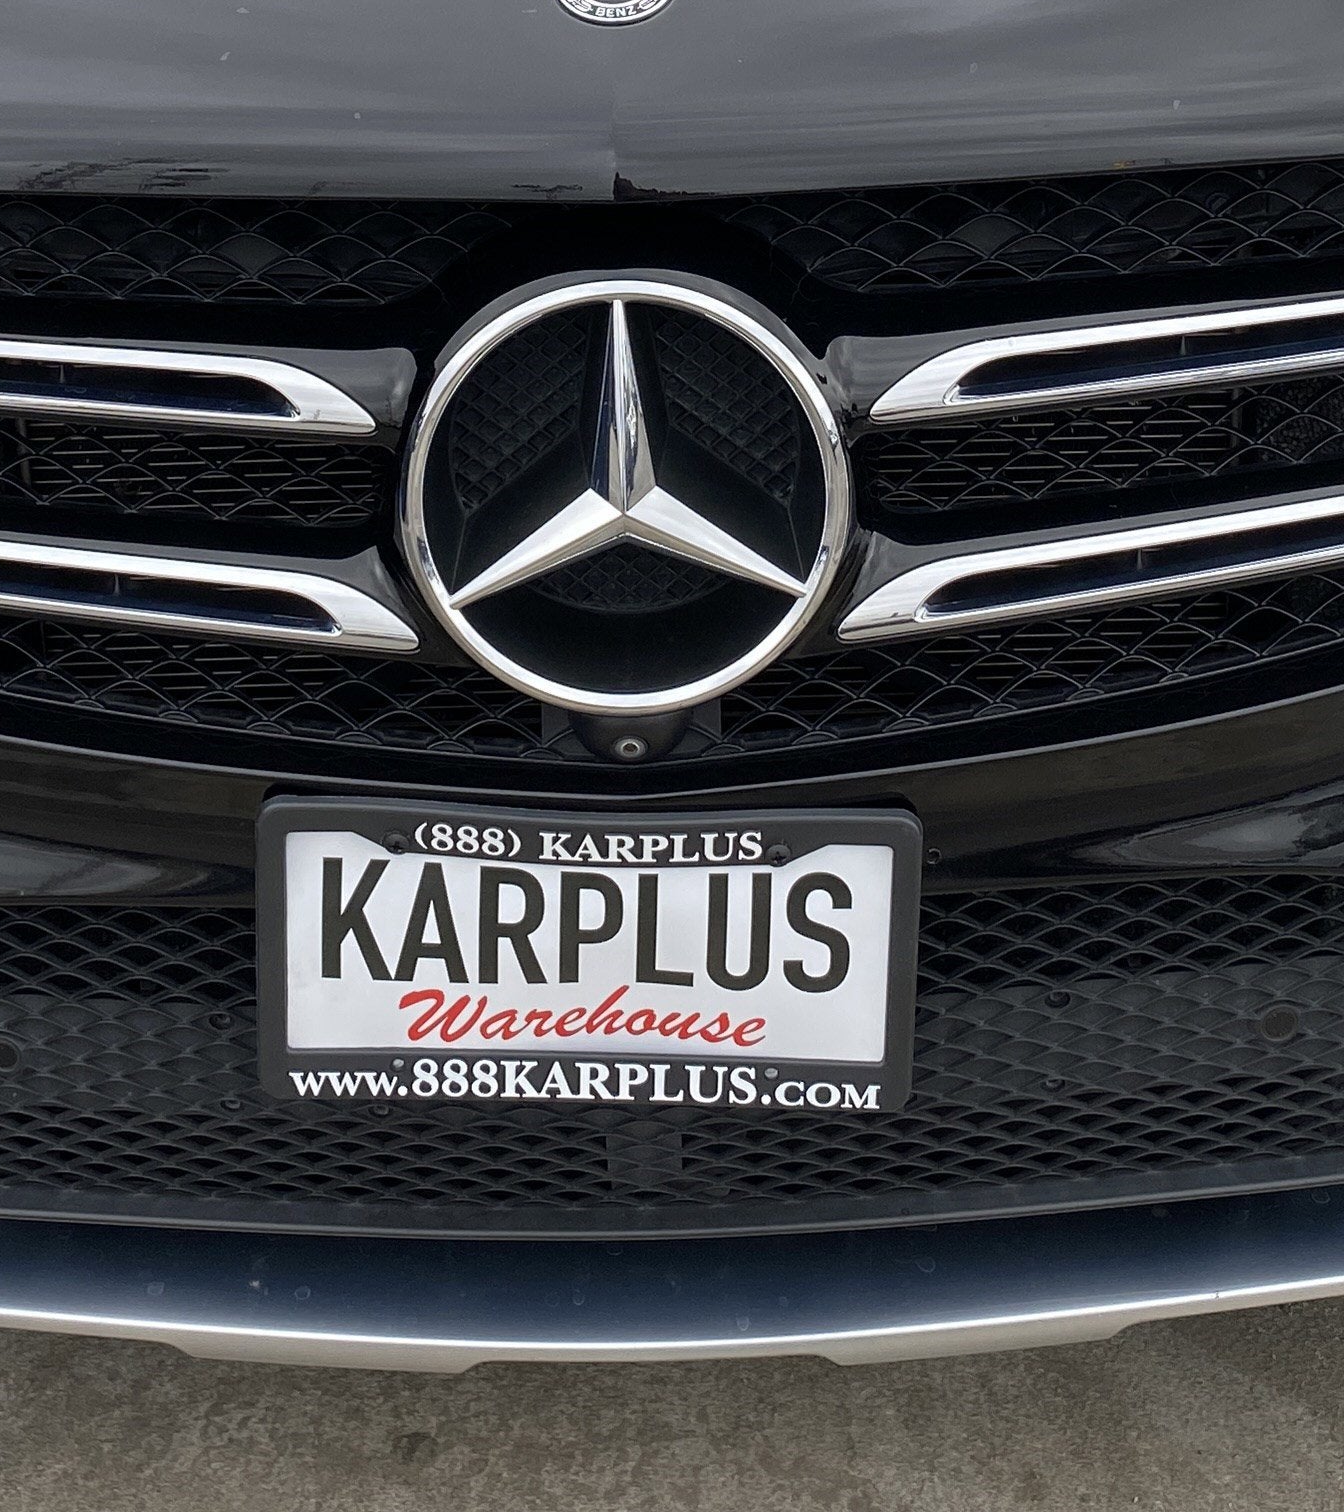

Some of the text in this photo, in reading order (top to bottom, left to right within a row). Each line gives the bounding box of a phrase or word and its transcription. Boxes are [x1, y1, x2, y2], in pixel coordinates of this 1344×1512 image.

[595, 5, 637, 18] BENZ
[414, 822, 763, 863] (888) KARPLUS
[321, 857, 853, 993] KARPLUS
[398, 985, 767, 1047] Warehouse
